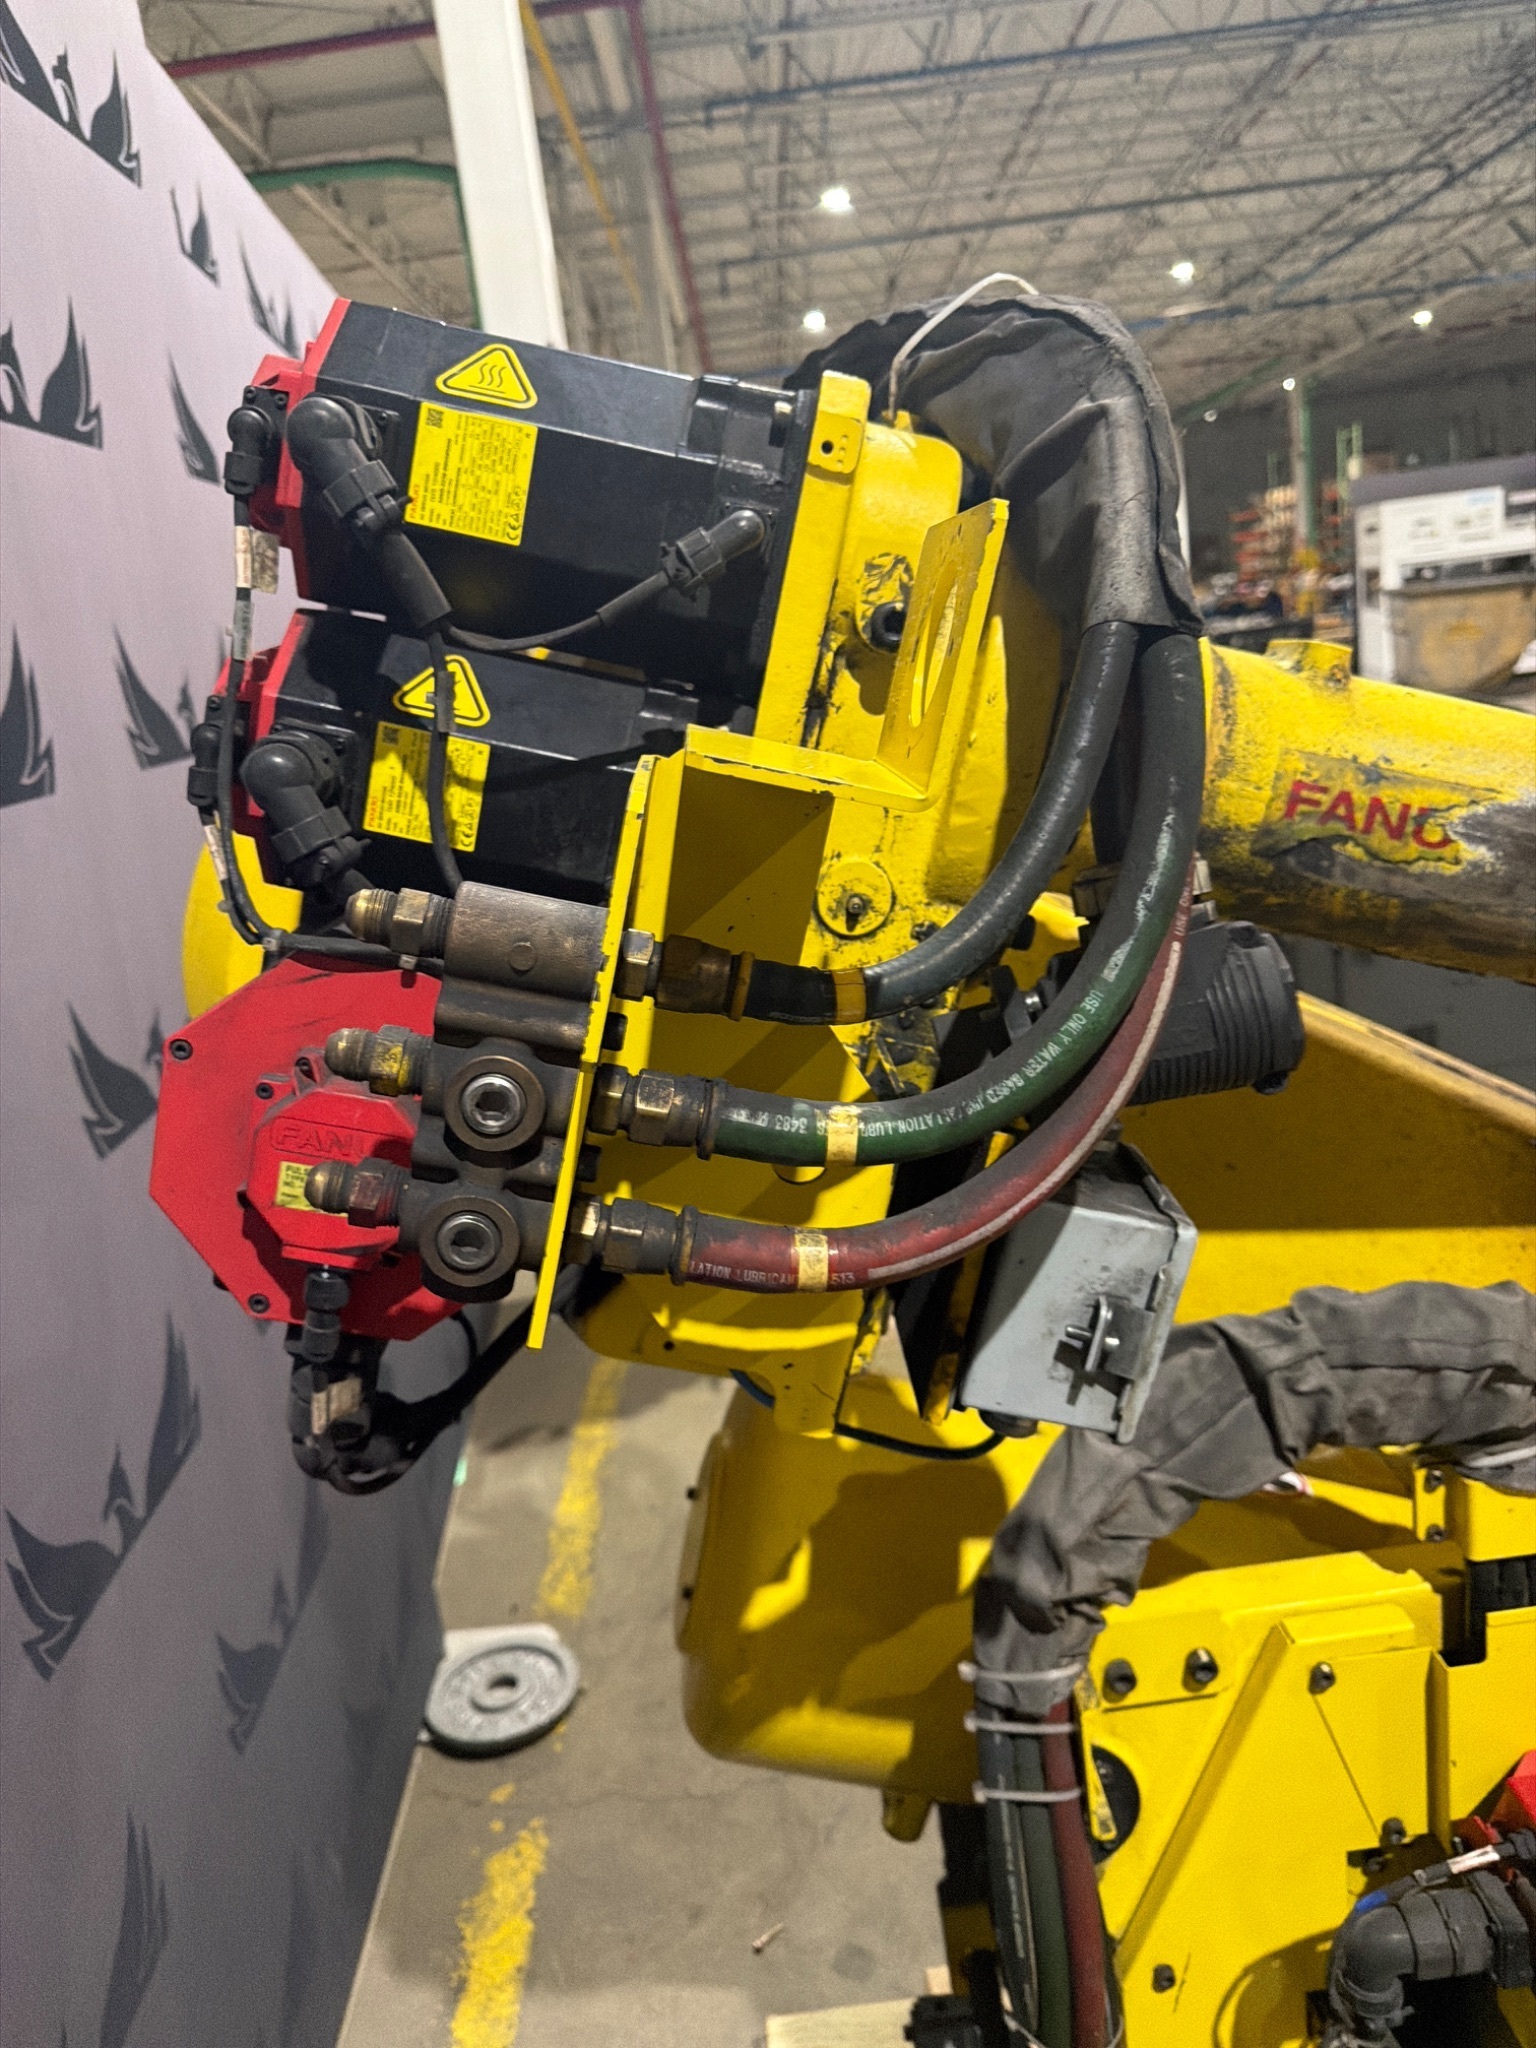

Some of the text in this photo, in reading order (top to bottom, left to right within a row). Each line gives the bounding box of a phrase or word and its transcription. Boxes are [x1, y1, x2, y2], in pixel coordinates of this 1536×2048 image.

[1283, 779, 1457, 850] FANU
[1080, 989, 1105, 1015] USE
[1057, 1012, 1089, 1046] ONLY
[1022, 1041, 1063, 1079] WATER
[986, 1072, 1025, 1104] BASED
[775, 1114, 809, 1135] 3483
[689, 1261, 732, 1280] LATION
[737, 1268, 798, 1285] LUBRICAN
